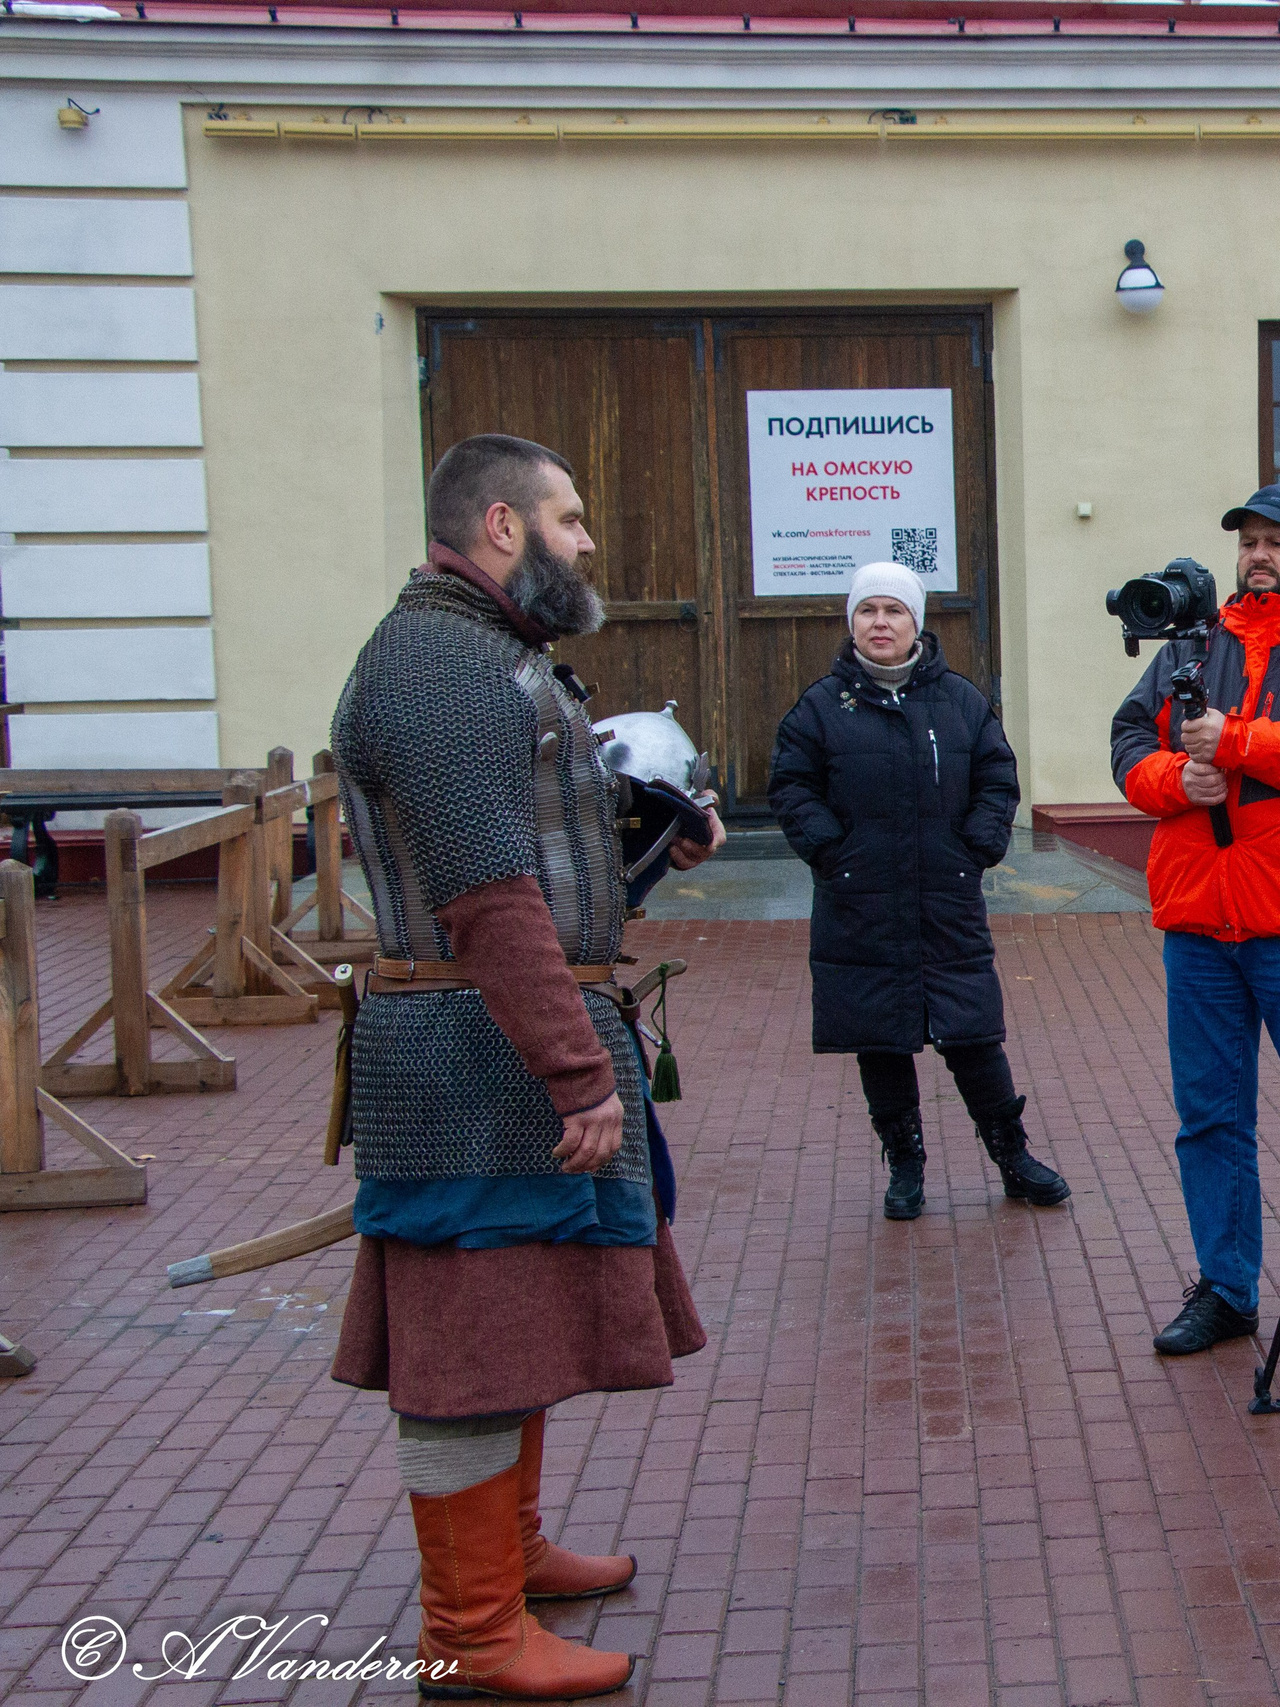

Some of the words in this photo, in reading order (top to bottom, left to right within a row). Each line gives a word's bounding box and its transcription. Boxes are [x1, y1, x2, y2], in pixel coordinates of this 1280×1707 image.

[767, 415, 934, 438] ПОДПИШИСЬ
[791, 462, 818, 476] НА
[824, 460, 913, 475] ОМСКУЮ
[806, 486, 900, 501] КРЕПОСТЬ
[771, 528, 871, 538] vk.com/omskfortress
